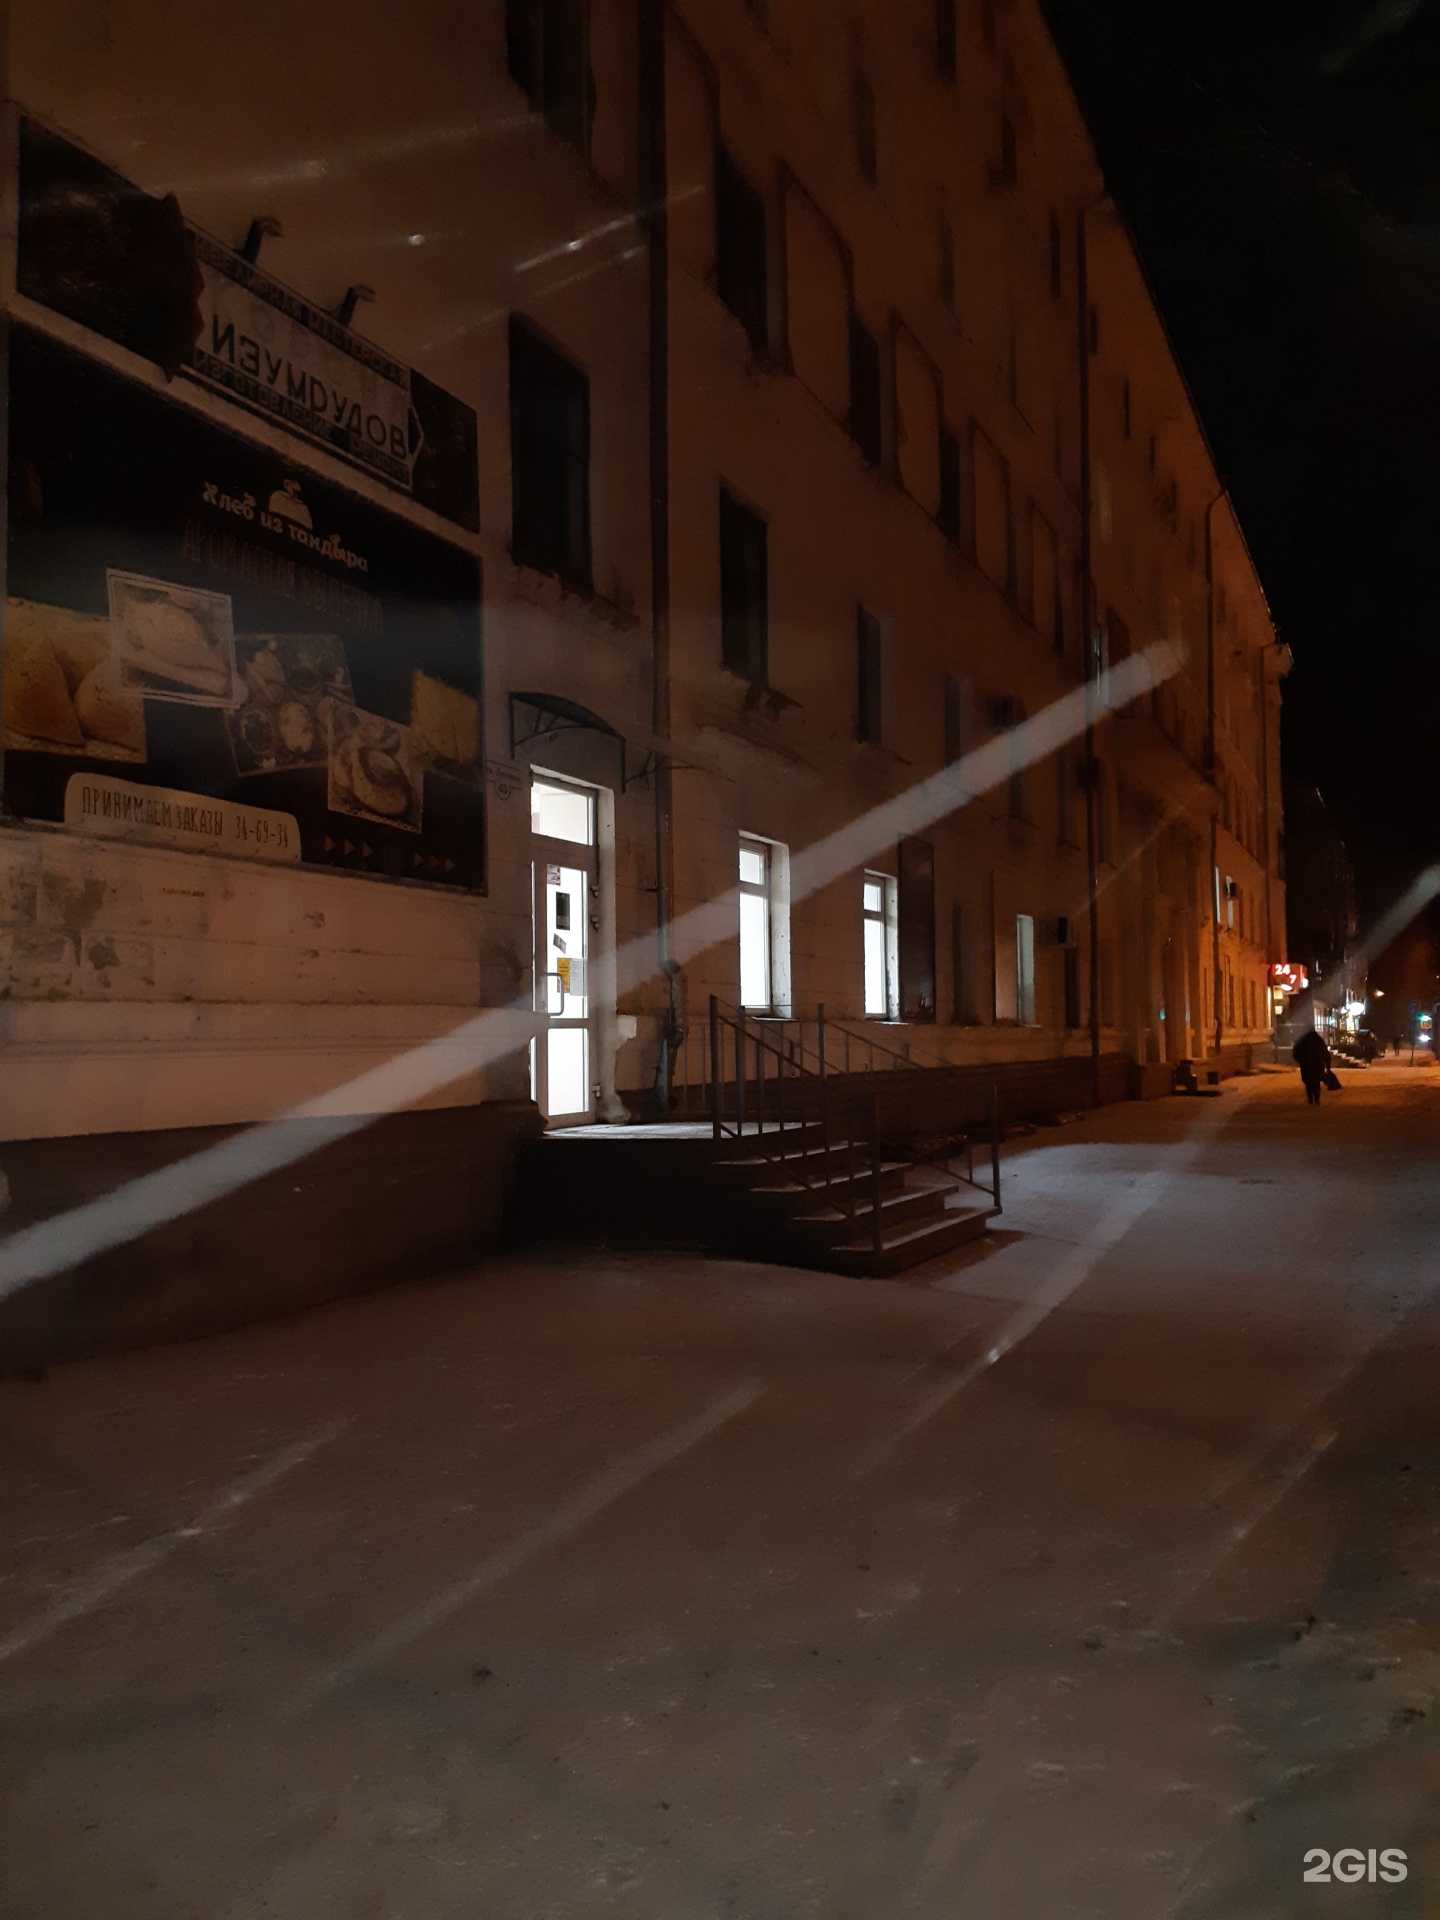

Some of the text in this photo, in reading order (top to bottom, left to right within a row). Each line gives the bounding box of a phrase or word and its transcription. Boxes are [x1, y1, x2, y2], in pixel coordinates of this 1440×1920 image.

[213, 313, 408, 460] ИЗУМРУДОВ
[260, 511, 285, 534] из
[175, 804, 223, 836] ЗАКАЗЫ
[1274, 963, 1291, 976] 24
